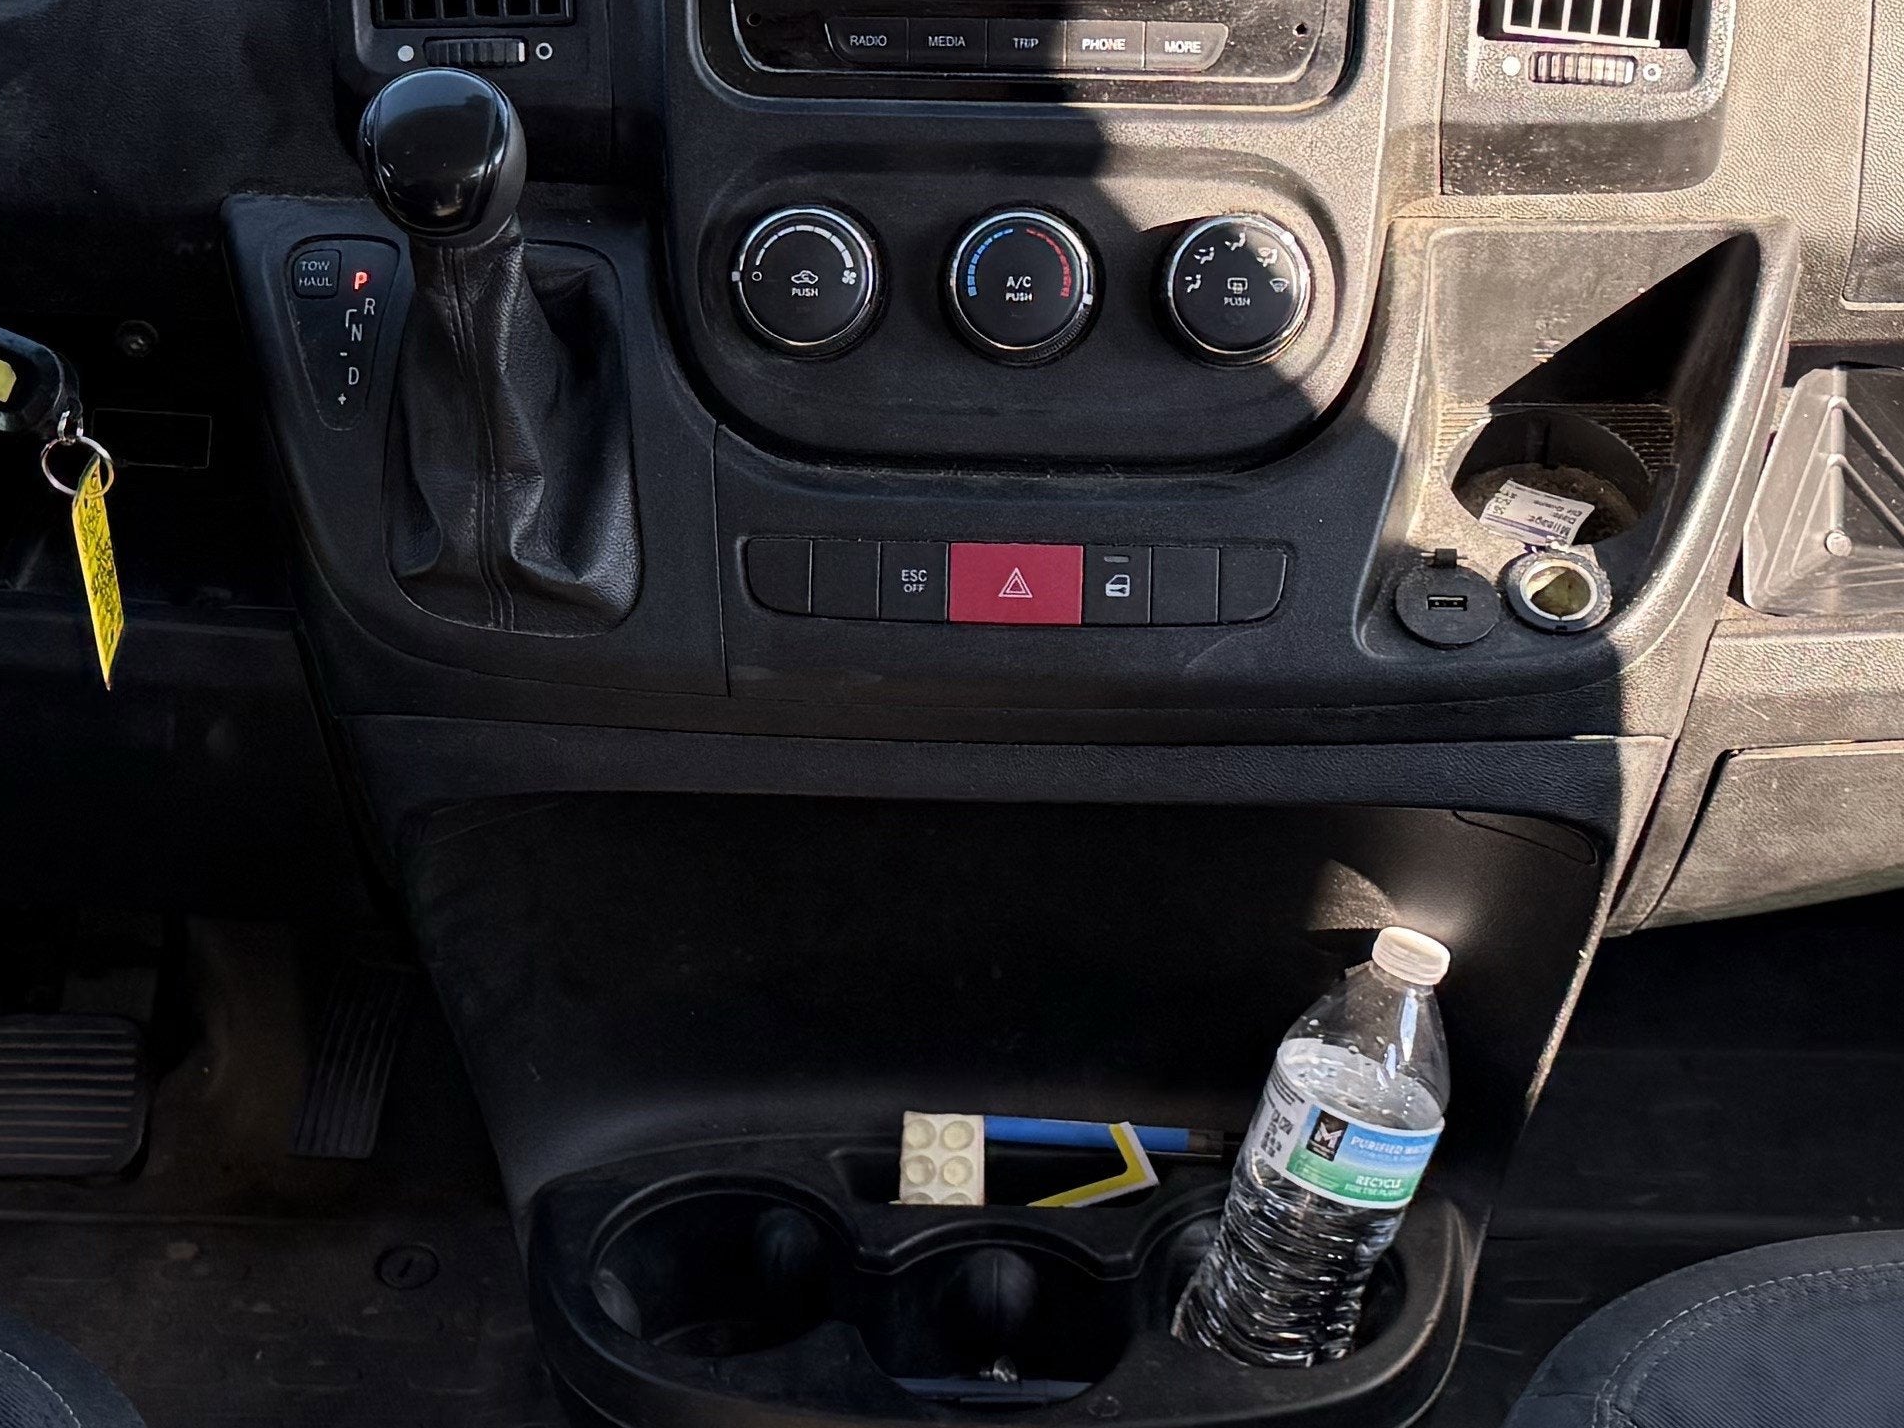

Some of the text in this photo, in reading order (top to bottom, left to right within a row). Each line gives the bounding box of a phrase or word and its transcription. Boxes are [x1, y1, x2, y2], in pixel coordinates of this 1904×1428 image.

[850, 35, 887, 47] RADIO
[928, 35, 966, 47] MEDIA
[1013, 37, 1039, 50] TRIP
[1082, 38, 1126, 51] PHONE
[1164, 40, 1202, 53] MORE
[300, 260, 330, 271] TOW
[299, 276, 333, 287] HAUL
[354, 271, 368, 290] P
[1007, 276, 1032, 287] A/C
[791, 287, 818, 297] PUSH
[1005, 292, 1033, 302] PUSH
[364, 298, 376, 316] R
[1224, 296, 1251, 306] PUSH
[351, 323, 363, 342] N
[348, 366, 360, 385] D
[901, 569, 928, 582] ESC
[903, 583, 925, 593] OFF
